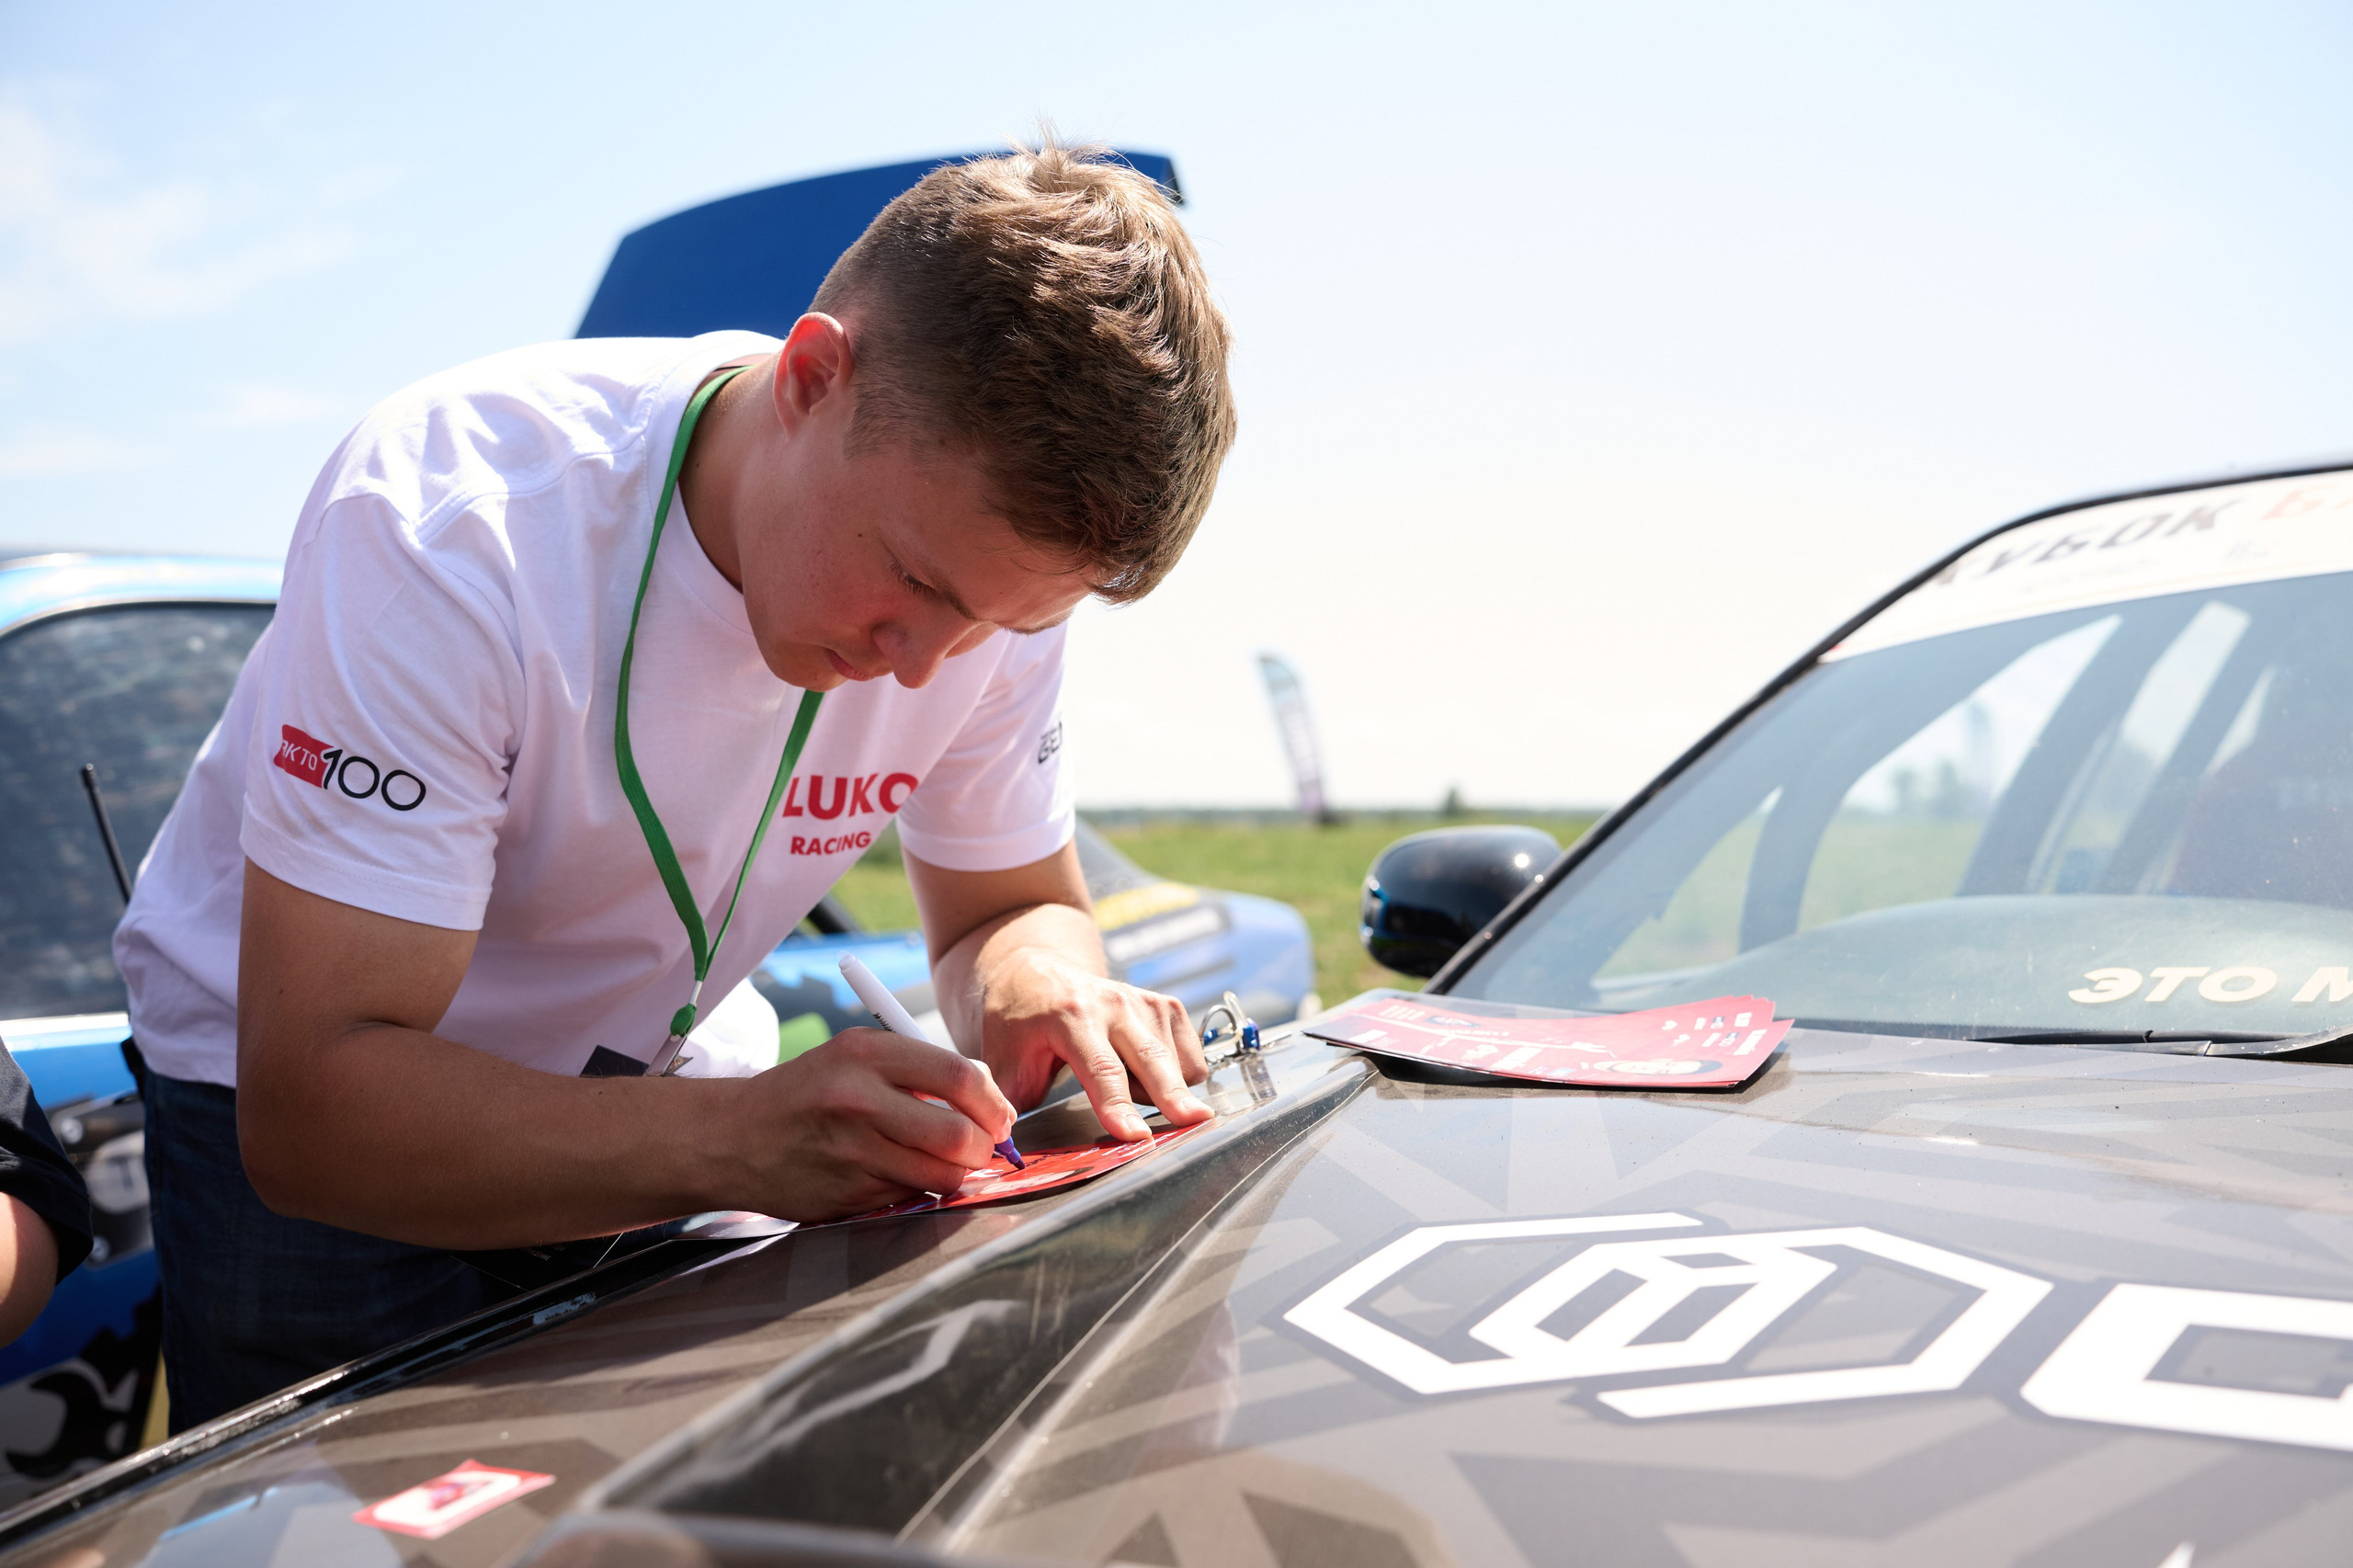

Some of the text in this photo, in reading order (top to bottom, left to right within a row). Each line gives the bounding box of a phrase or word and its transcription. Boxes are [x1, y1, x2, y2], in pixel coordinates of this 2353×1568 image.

[323, 748, 426, 812] 100
[782, 772, 919, 820] LUKO
[790, 831, 871, 856] RACING
[2067, 966, 2278, 1004] ЭТО
